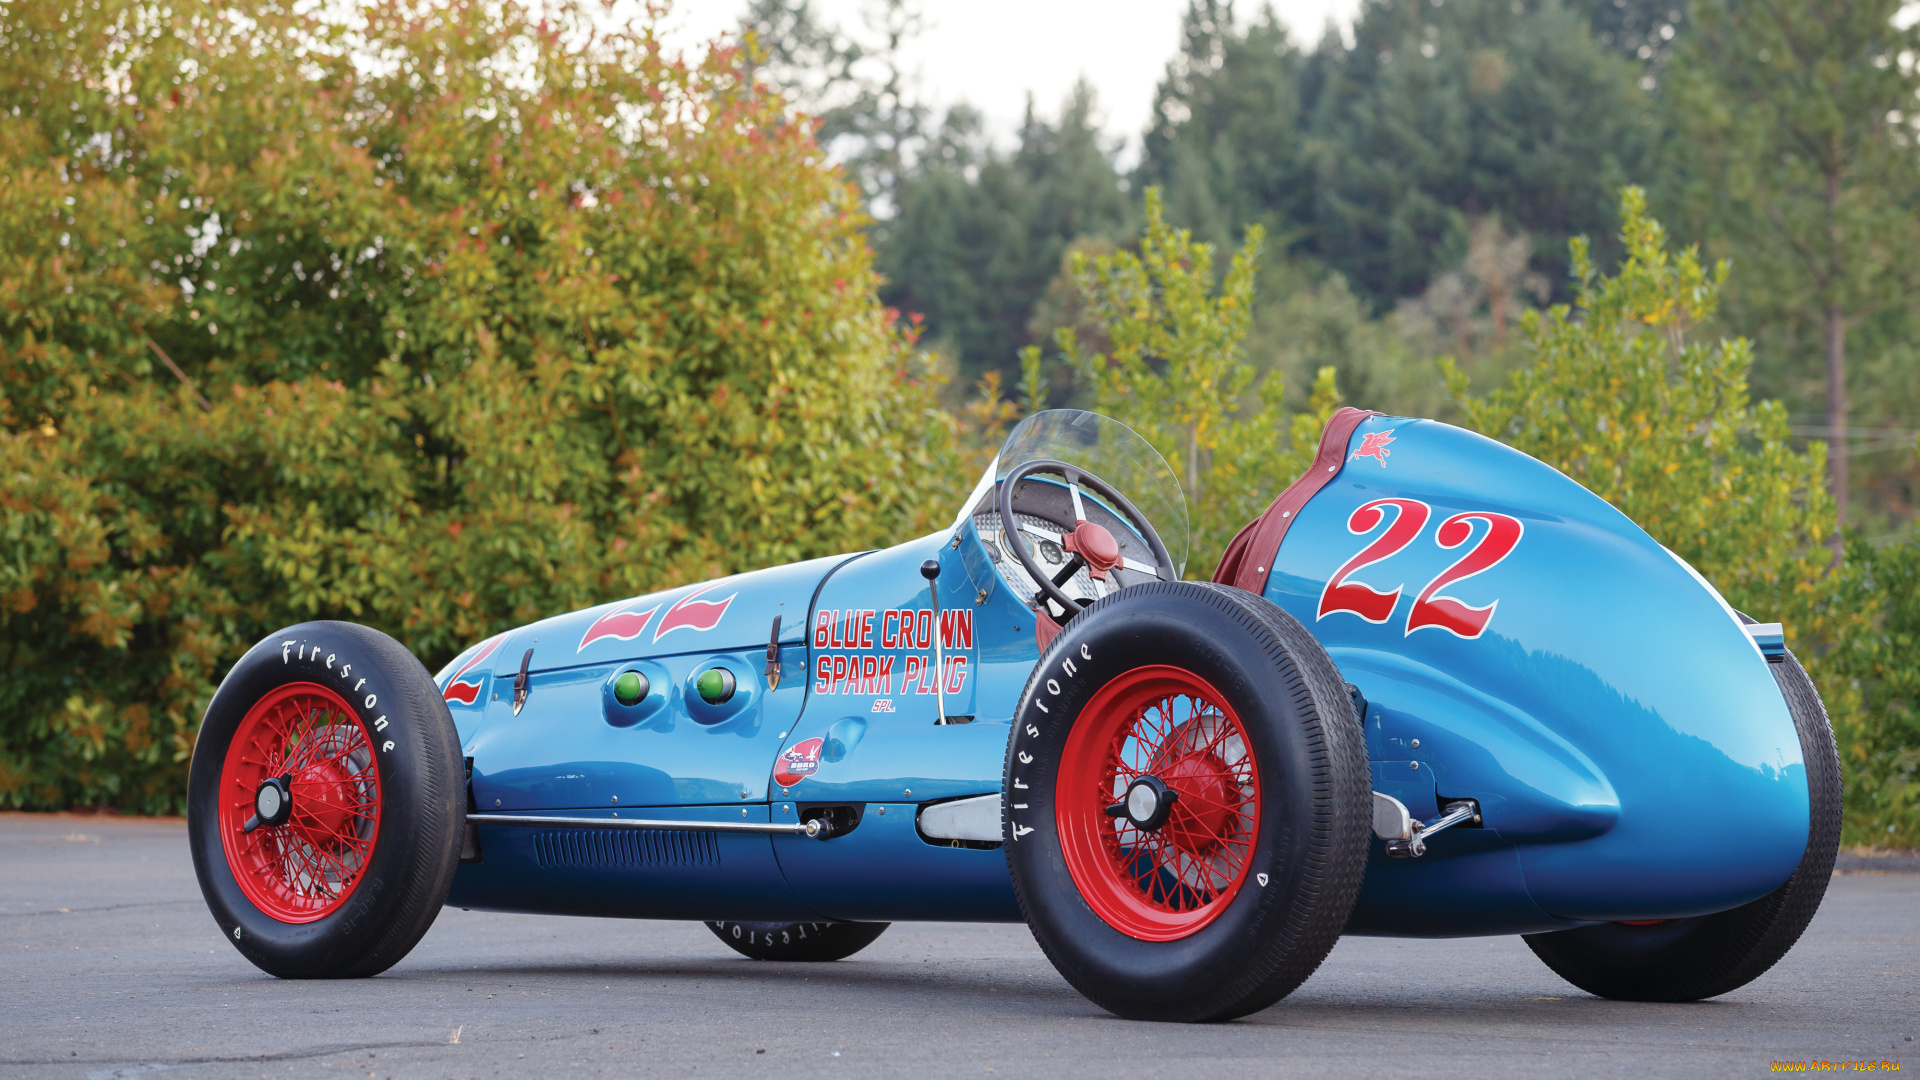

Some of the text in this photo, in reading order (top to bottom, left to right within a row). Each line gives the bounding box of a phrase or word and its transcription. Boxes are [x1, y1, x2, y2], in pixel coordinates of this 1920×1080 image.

[1316, 497, 1524, 640] 22
[814, 608, 973, 650] BLUE CROWN
[815, 655, 968, 695] SPARK PLUG
[281, 639, 395, 753] Firestone
[1011, 642, 1092, 842] Firestone
